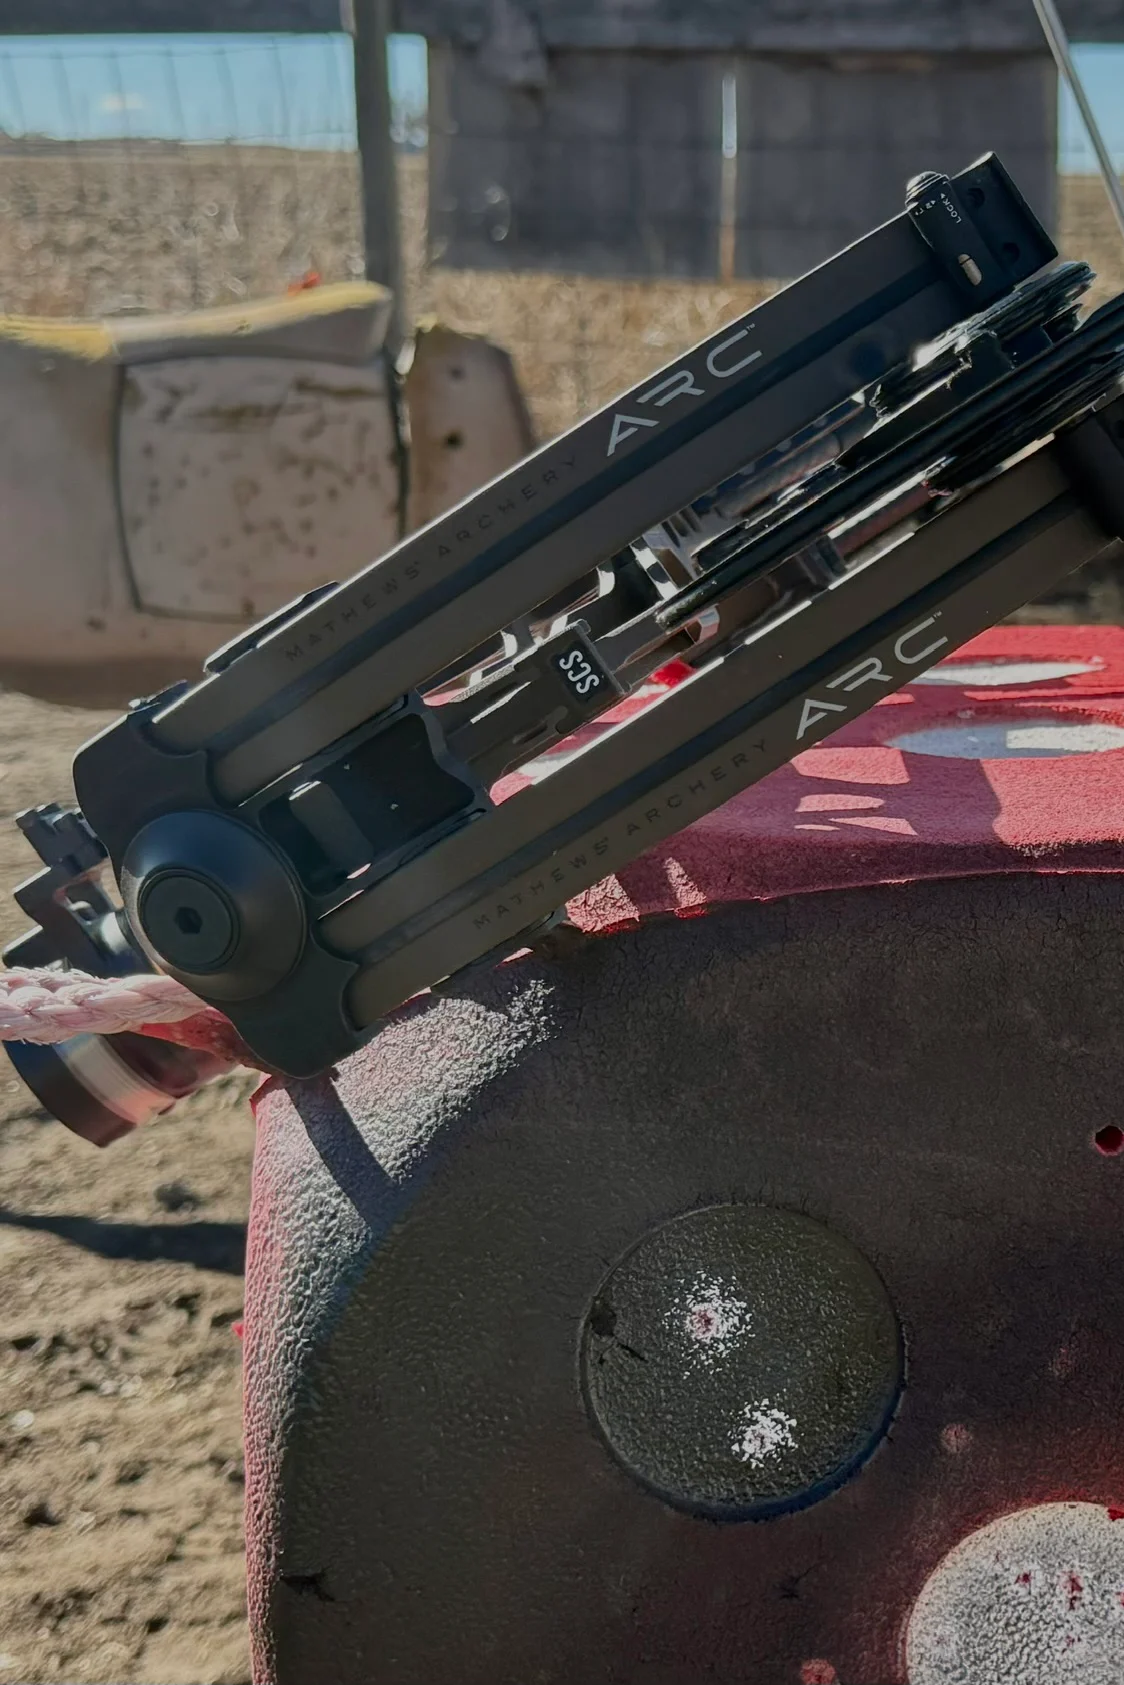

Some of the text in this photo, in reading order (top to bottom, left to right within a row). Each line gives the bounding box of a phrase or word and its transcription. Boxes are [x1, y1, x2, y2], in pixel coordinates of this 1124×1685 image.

[942, 198, 962, 224] LOCK
[437, 455, 577, 560] ARCHERY
[558, 650, 600, 695] SCS
[627, 738, 767, 837] ARCHERY
